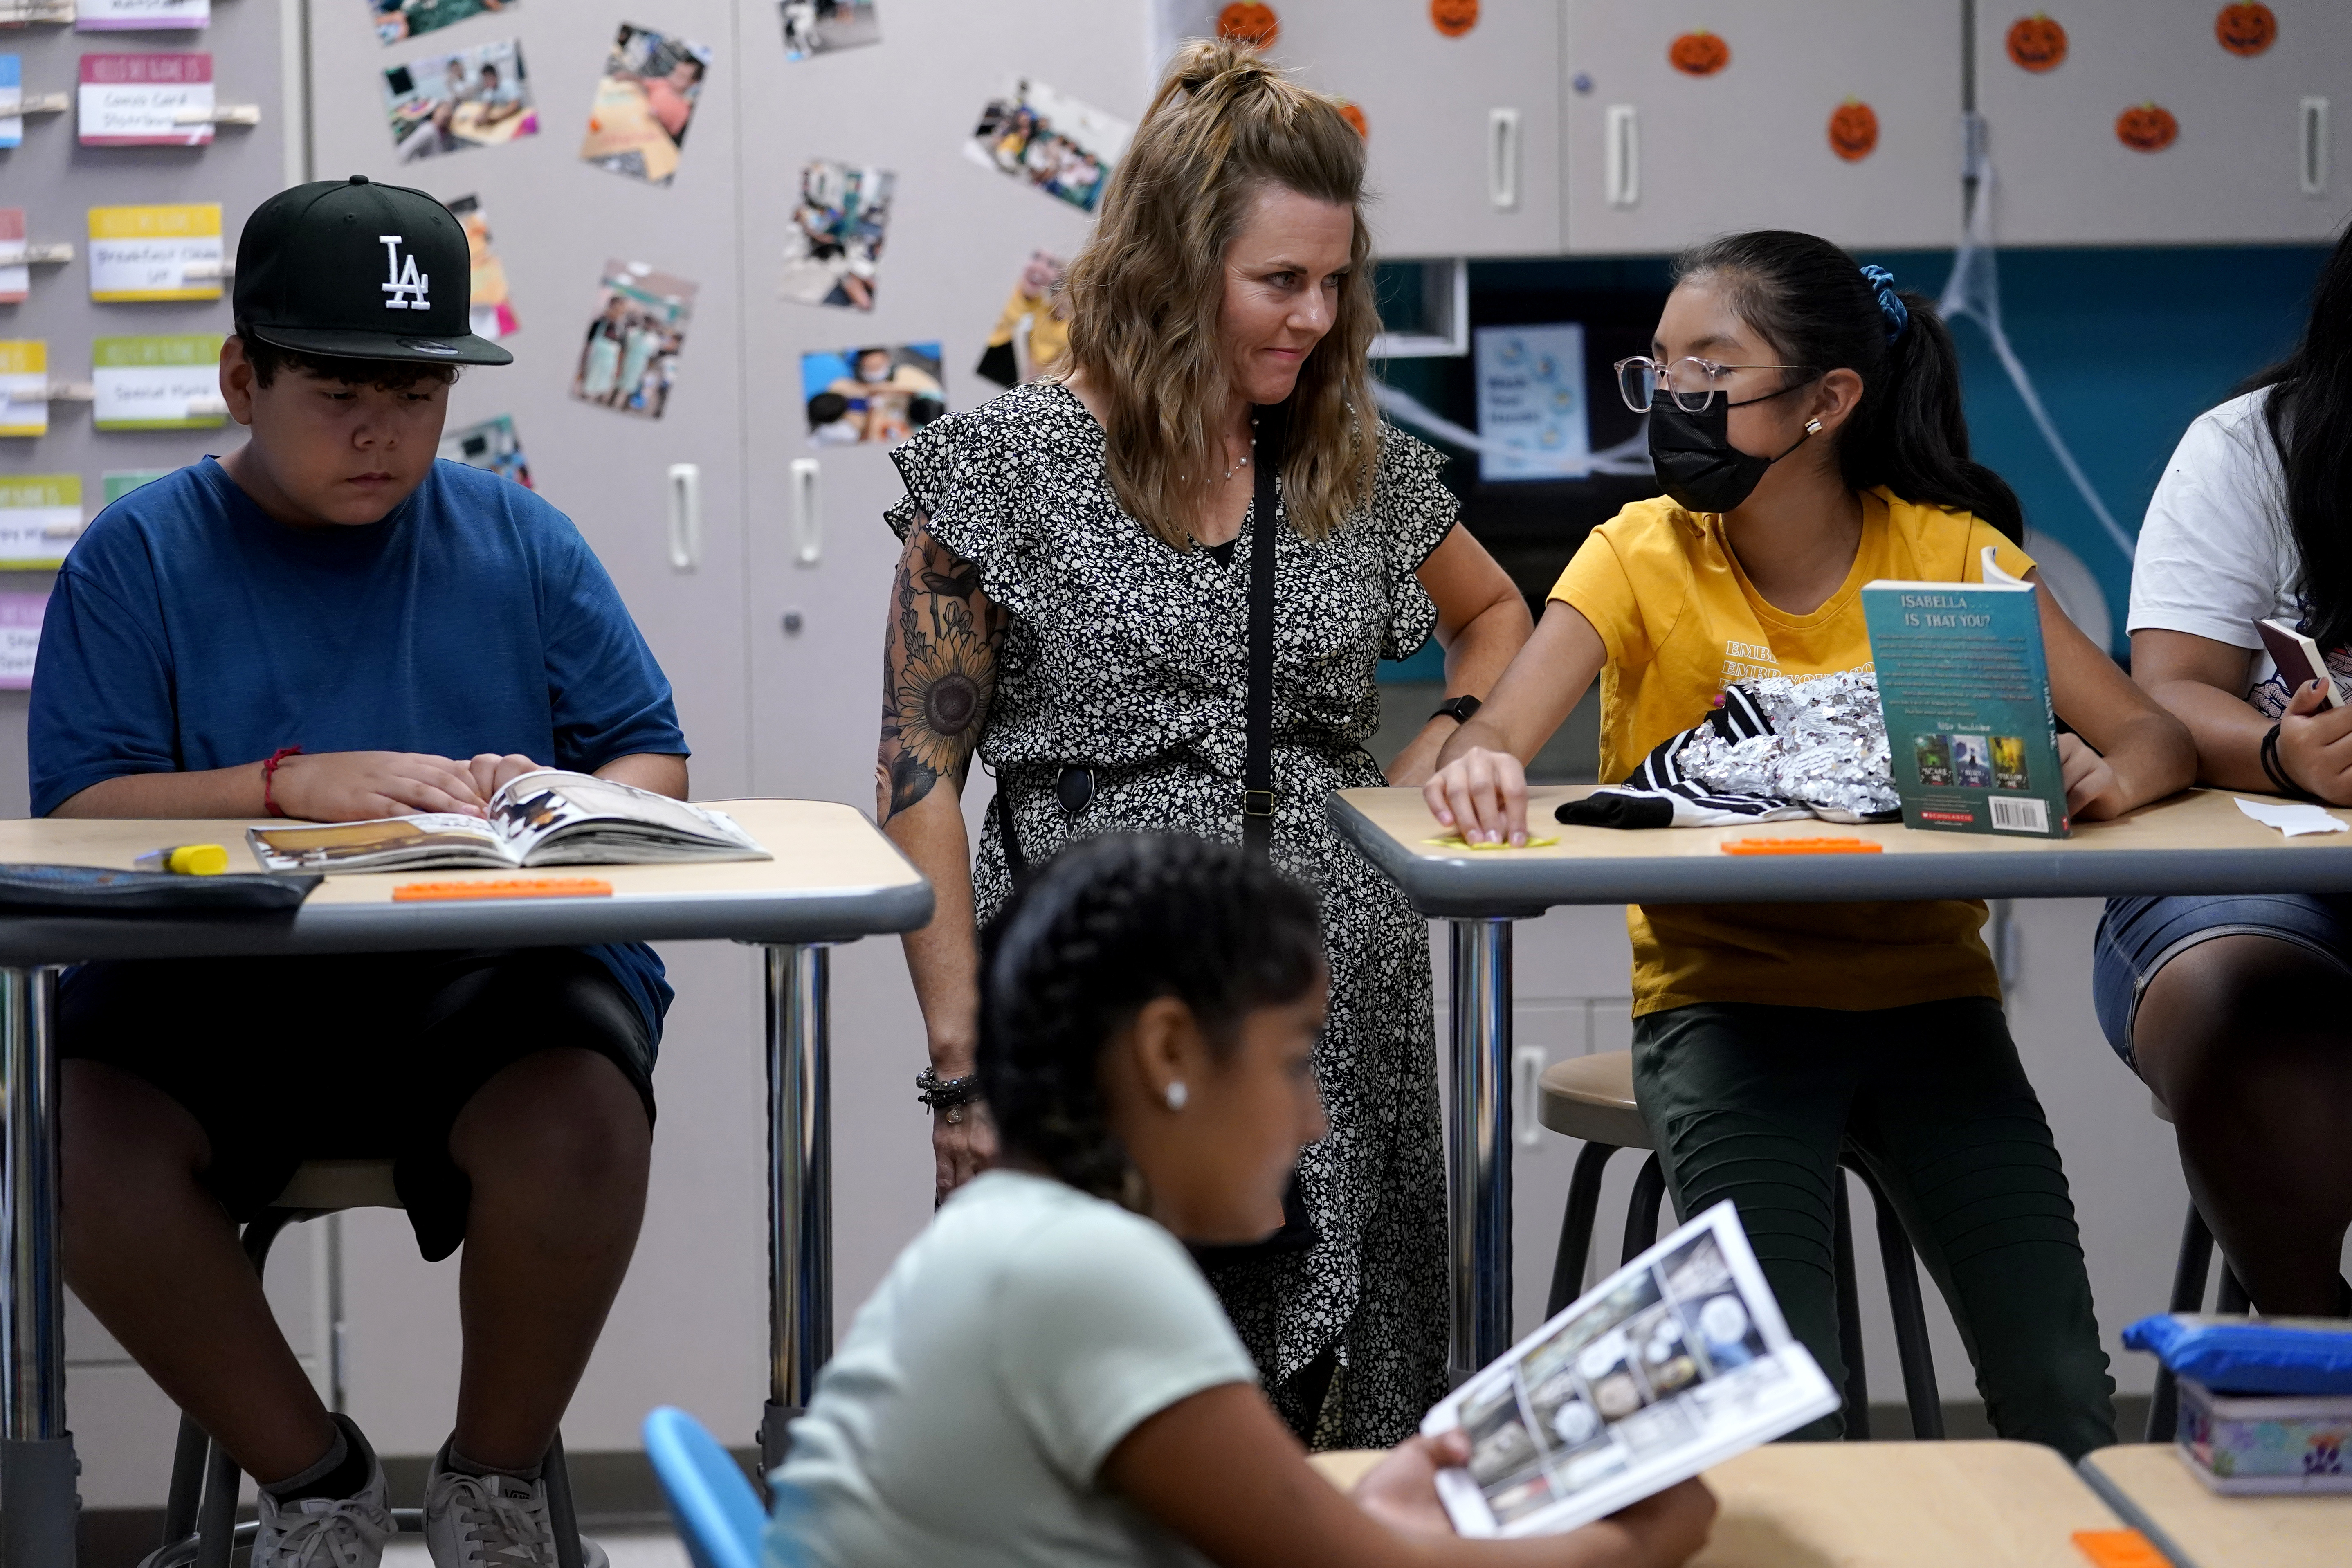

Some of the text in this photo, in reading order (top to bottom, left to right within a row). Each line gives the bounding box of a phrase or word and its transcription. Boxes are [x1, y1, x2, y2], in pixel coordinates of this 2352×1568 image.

[379, 235, 430, 310] LA
[1901, 595, 1967, 609] ISABELLA
[1905, 613, 1990, 627] IS THAT YOU?
